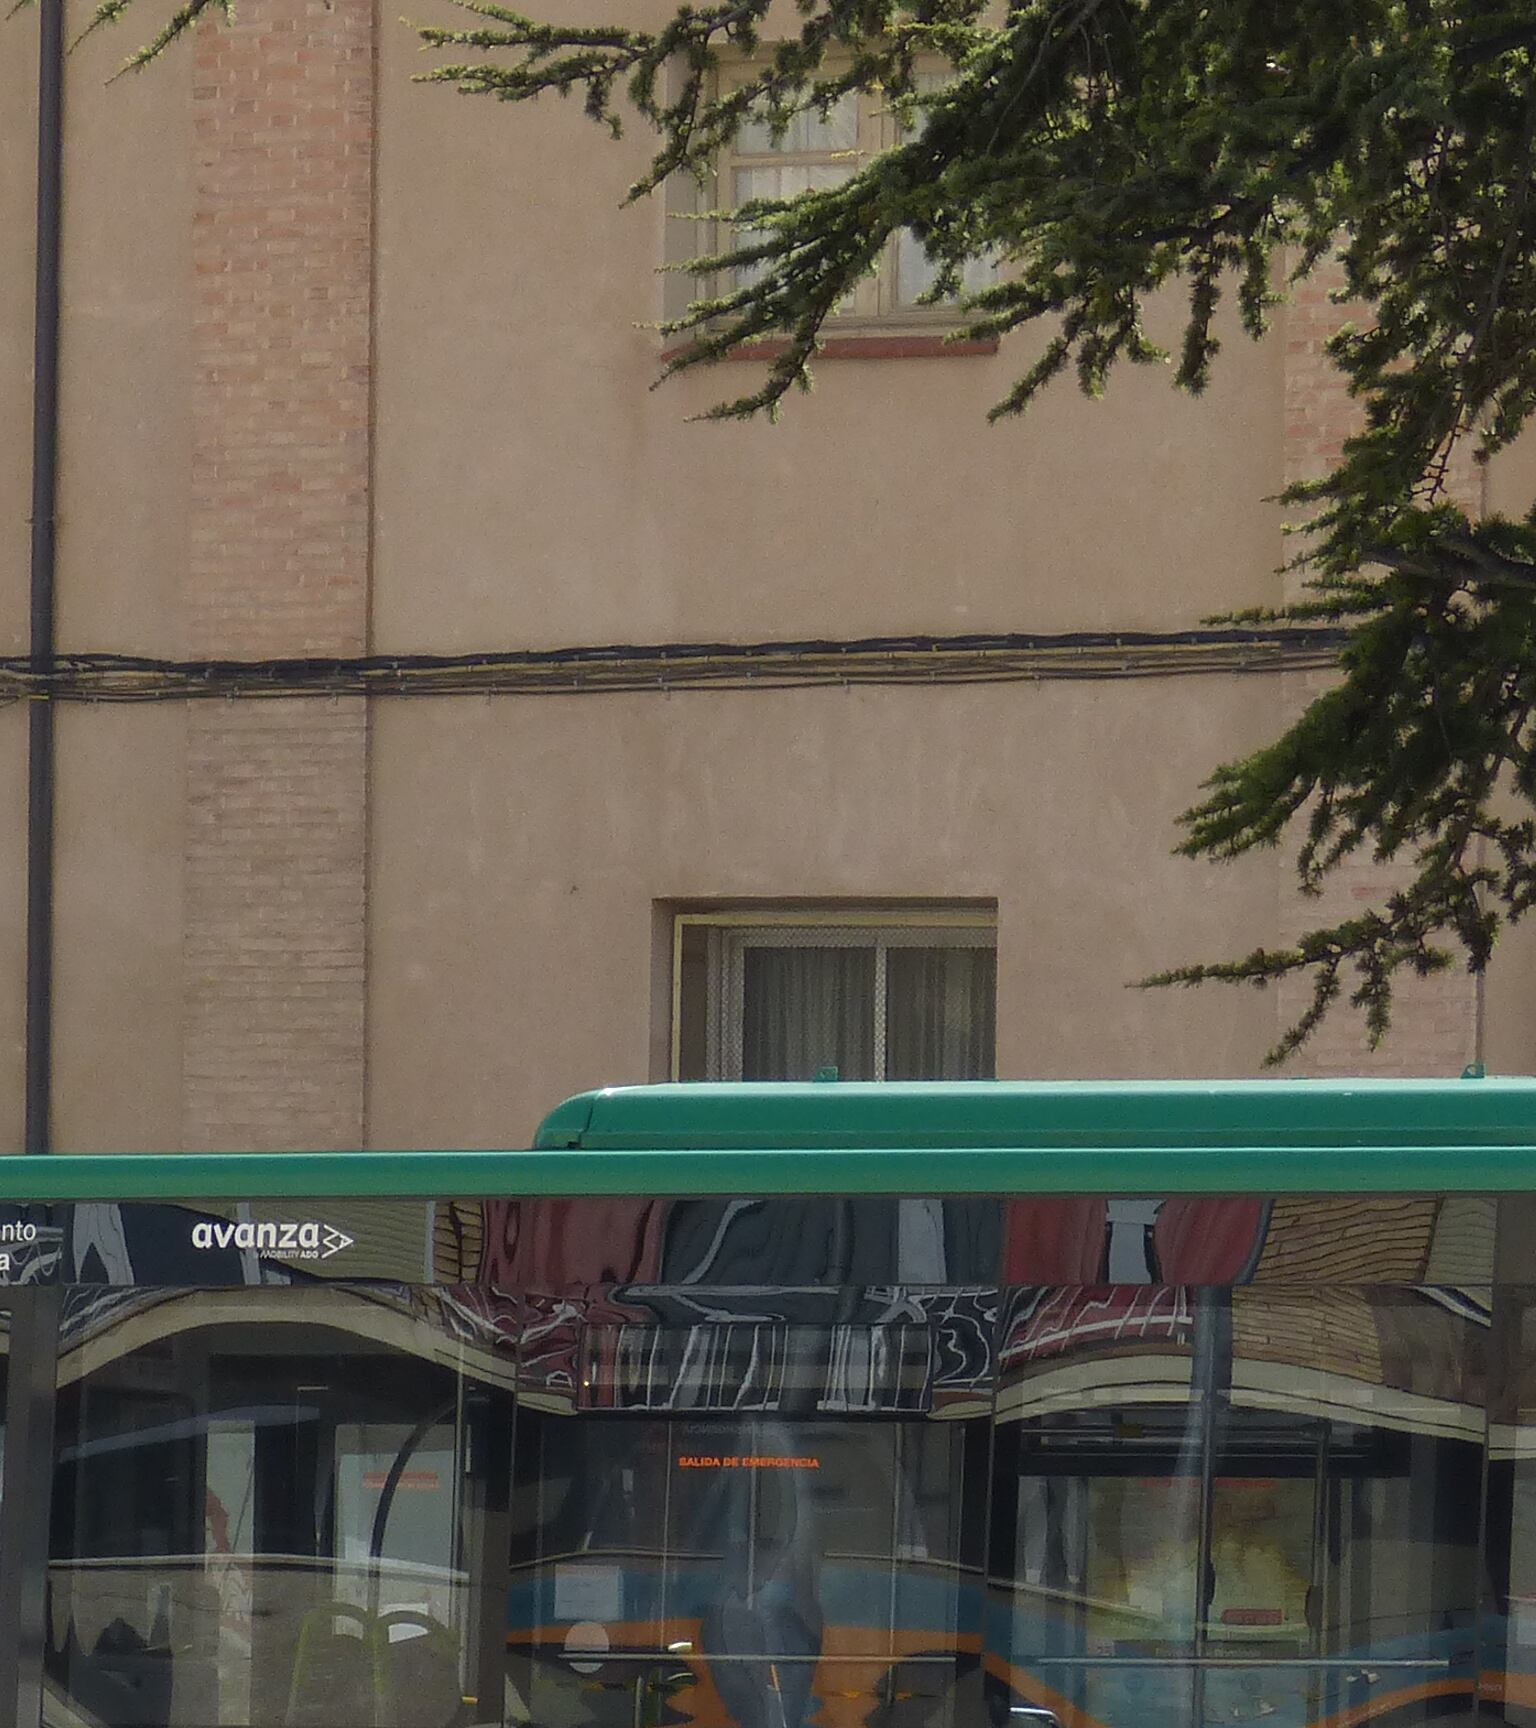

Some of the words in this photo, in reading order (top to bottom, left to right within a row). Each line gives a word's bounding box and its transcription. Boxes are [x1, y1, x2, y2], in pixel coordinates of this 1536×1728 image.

[191, 1222, 321, 1249] avanza
[300, 1251, 319, 1260] ADO
[678, 1457, 721, 1468] SALIDA
[722, 1457, 739, 1468] DE
[741, 1457, 820, 1469] EMERGENCIA
